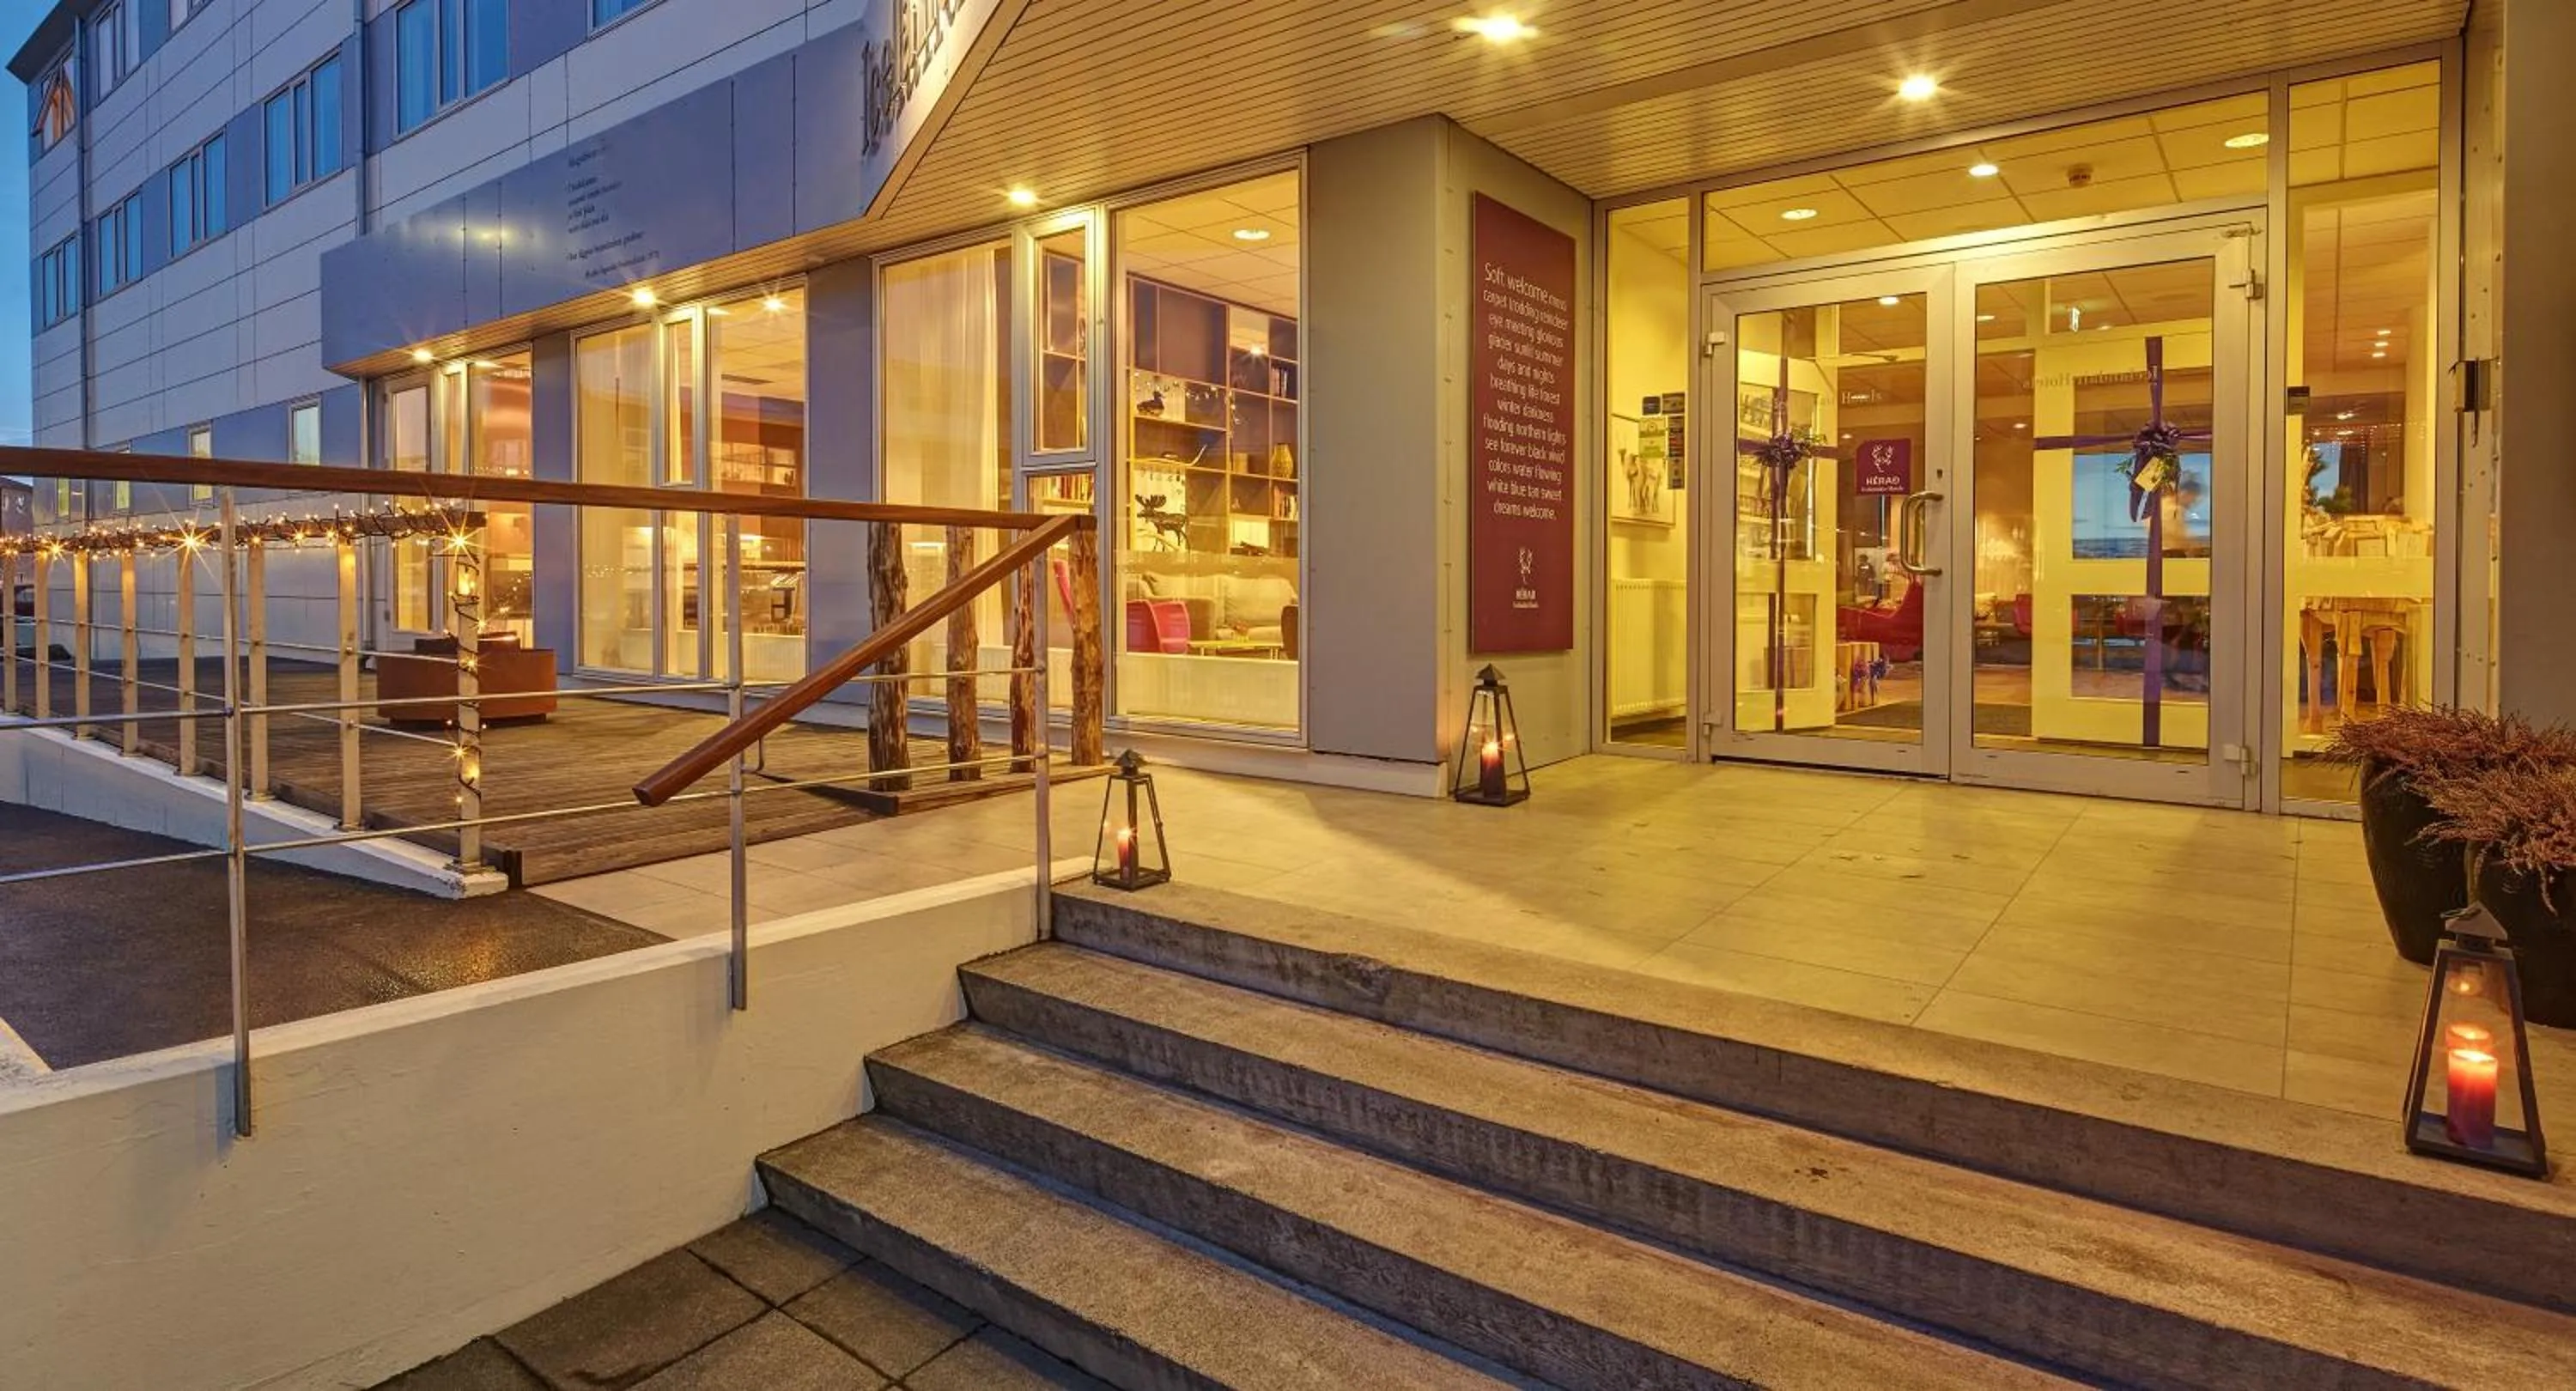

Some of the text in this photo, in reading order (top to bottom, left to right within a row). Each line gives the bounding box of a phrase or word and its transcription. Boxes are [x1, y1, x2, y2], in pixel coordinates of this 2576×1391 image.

[1484, 262, 1505, 288] Soft
[1507, 275, 1548, 303] welcome
[1483, 289, 1507, 308] carpet
[1509, 297, 1540, 324] trodding
[1488, 313, 1564, 348] eye meeting glorious
[1497, 354, 1555, 386] days and nights
[1490, 372, 1560, 404] breathing life forest
[1497, 399, 1553, 423] winter darkness
[1483, 412, 1566, 446] flooding northern lights
[1485, 437, 1498, 451] see
[1500, 436, 1528, 456] forever
[1528, 443, 1546, 460] black
[1488, 457, 1563, 485] colors water flowing
[1487, 477, 1509, 494] white
[1510, 480, 1527, 497] blue
[1540, 486, 1562, 501] sweet
[1493, 499, 1558, 520] dreams welcome.
